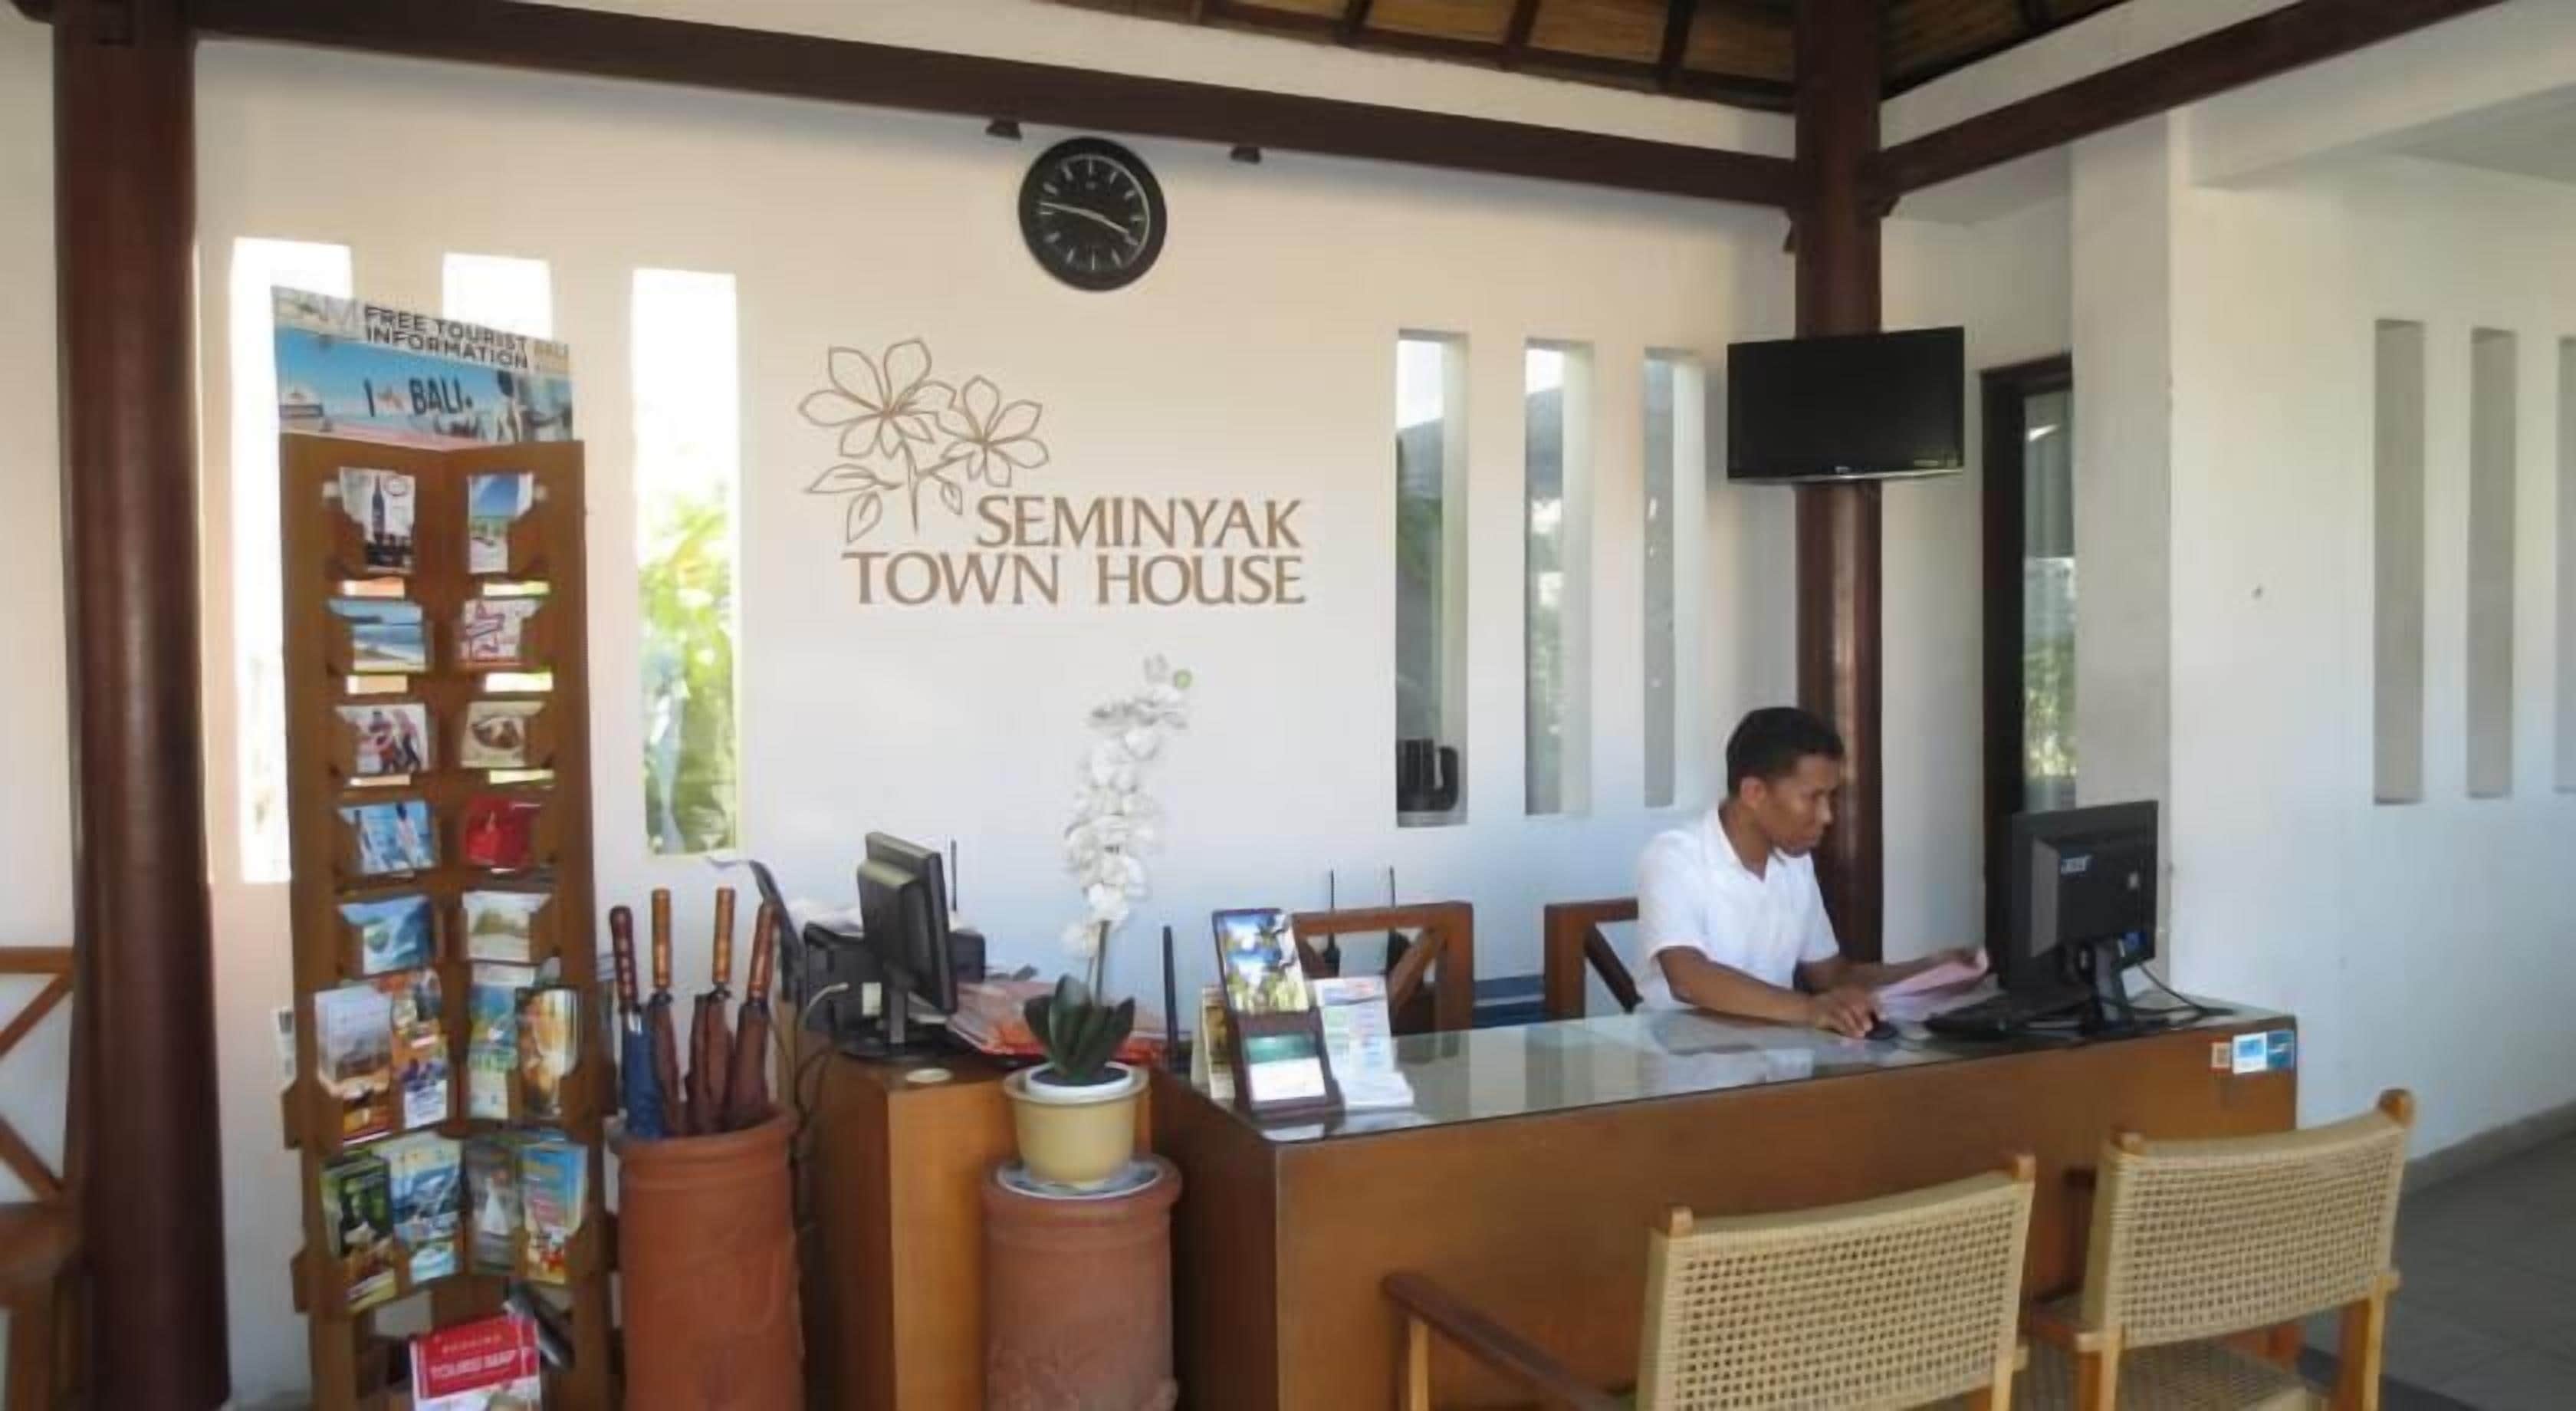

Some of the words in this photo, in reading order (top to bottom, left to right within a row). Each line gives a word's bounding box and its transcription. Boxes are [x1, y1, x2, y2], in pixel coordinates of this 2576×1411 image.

[364, 304, 429, 332] FREE
[436, 317, 529, 350] TOURIST
[366, 325, 529, 369] INFORMATION
[975, 494, 1303, 548] SEMINYAK
[841, 550, 1060, 604] TOWN
[1096, 554, 1306, 604] HOUSE
